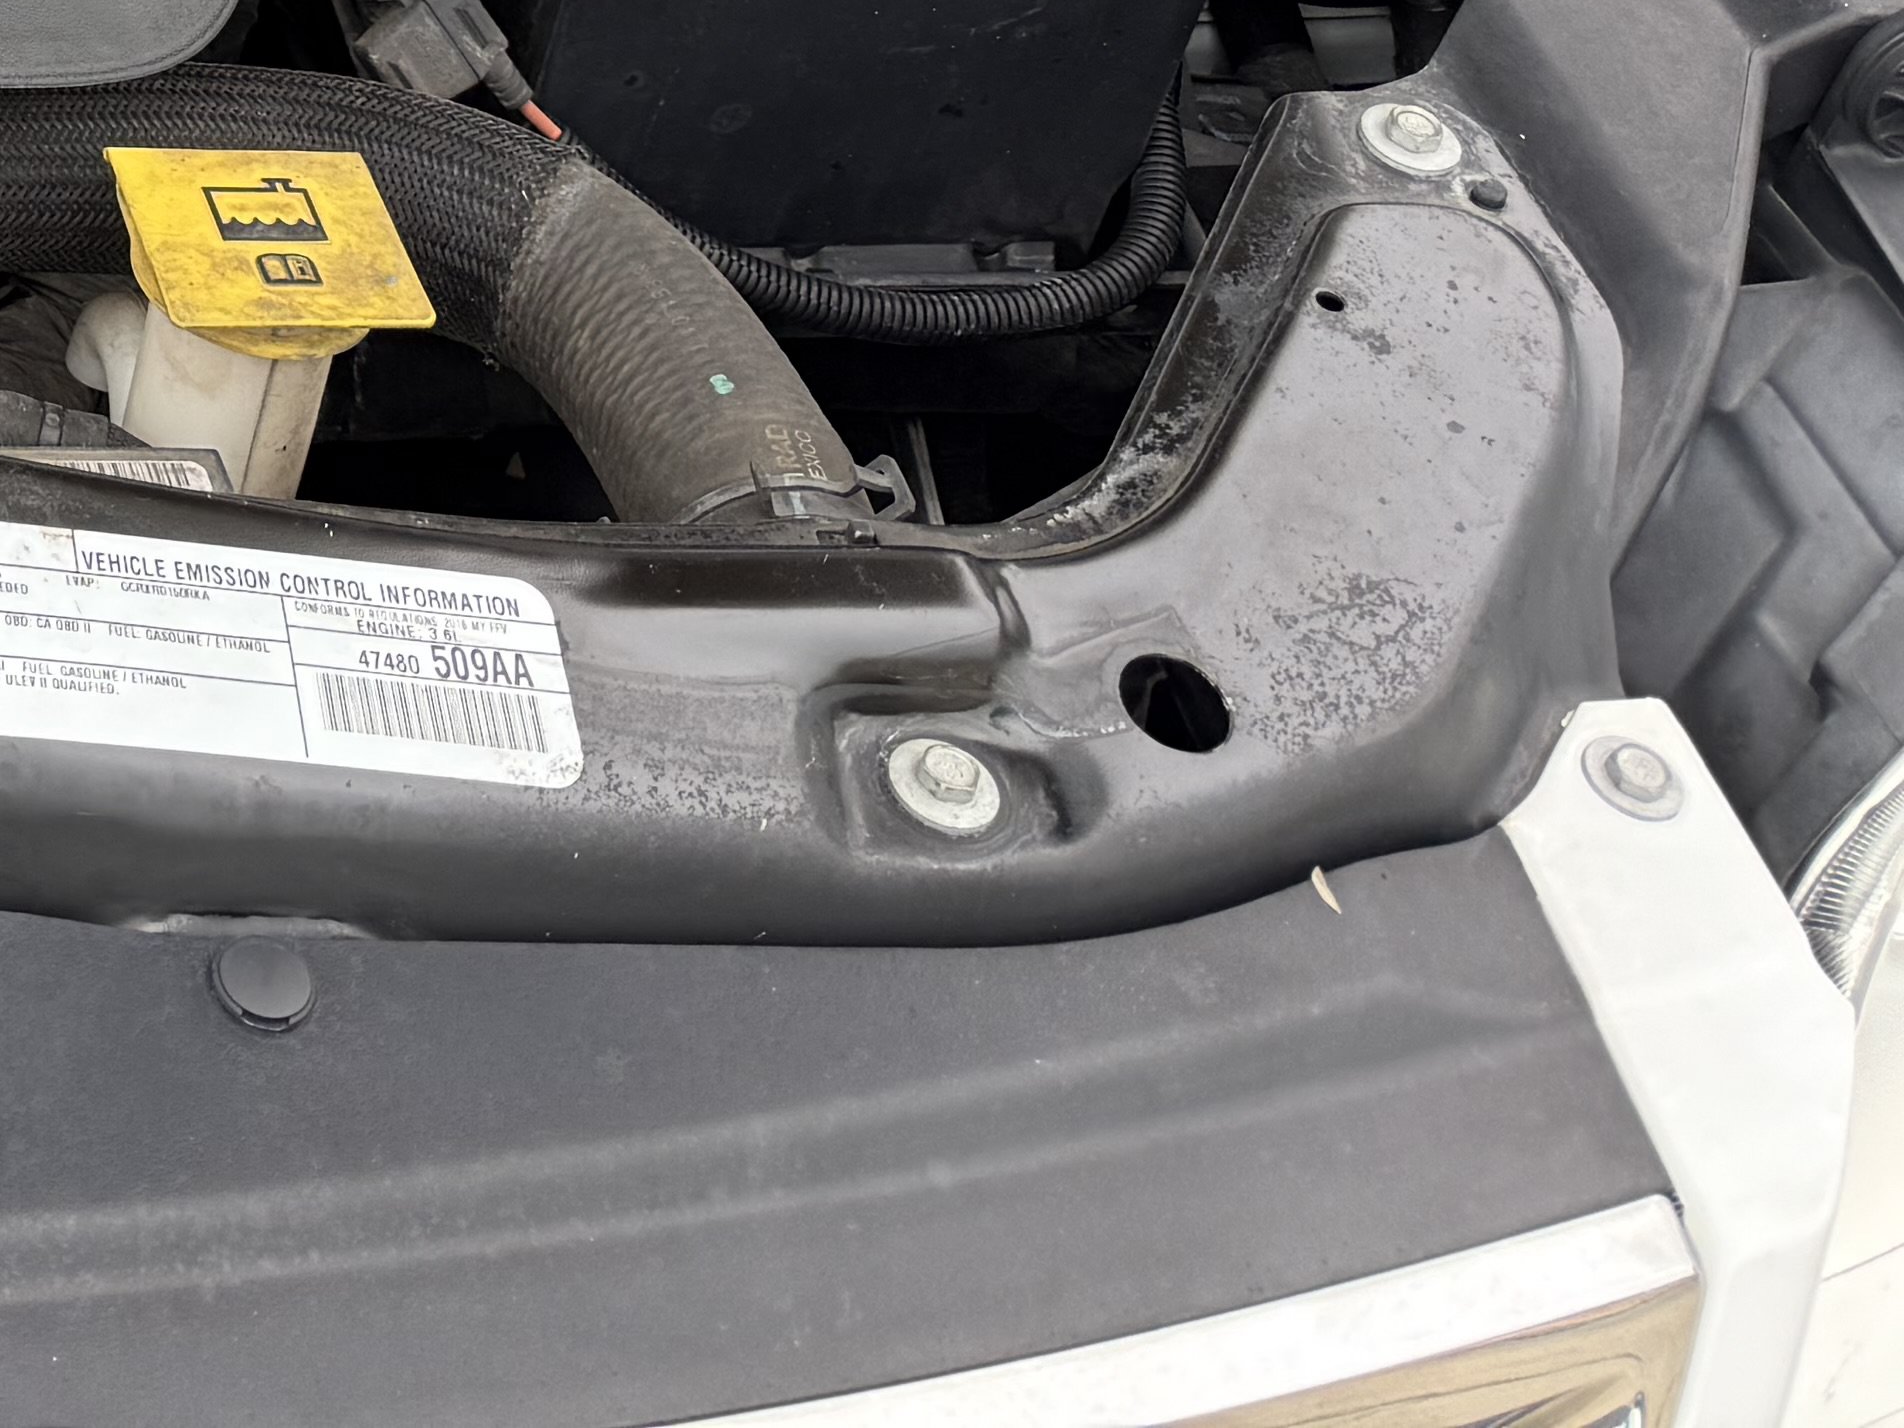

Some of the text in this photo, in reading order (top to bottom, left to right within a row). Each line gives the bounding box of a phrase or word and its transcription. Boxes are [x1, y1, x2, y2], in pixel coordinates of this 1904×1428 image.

[81, 550, 167, 578] VEHICLE
[175, 561, 271, 590] EMISSION
[280, 572, 373, 602] CONTROL
[379, 583, 521, 618] INFORMATION
[294, 601, 350, 617] CONFORMS
[36, 617, 52, 629] CA
[55, 619, 80, 632] OBD
[145, 628, 202, 647] GASOLINE
[215, 636, 271, 654] ETHANOL
[60, 666, 120, 682] GASOLINE
[132, 674, 188, 690] ETHANOL
[358, 645, 535, 687] 47480 509AA
[5, 674, 36, 687] ULEV
[52, 677, 121, 695] QUALIFIED.
